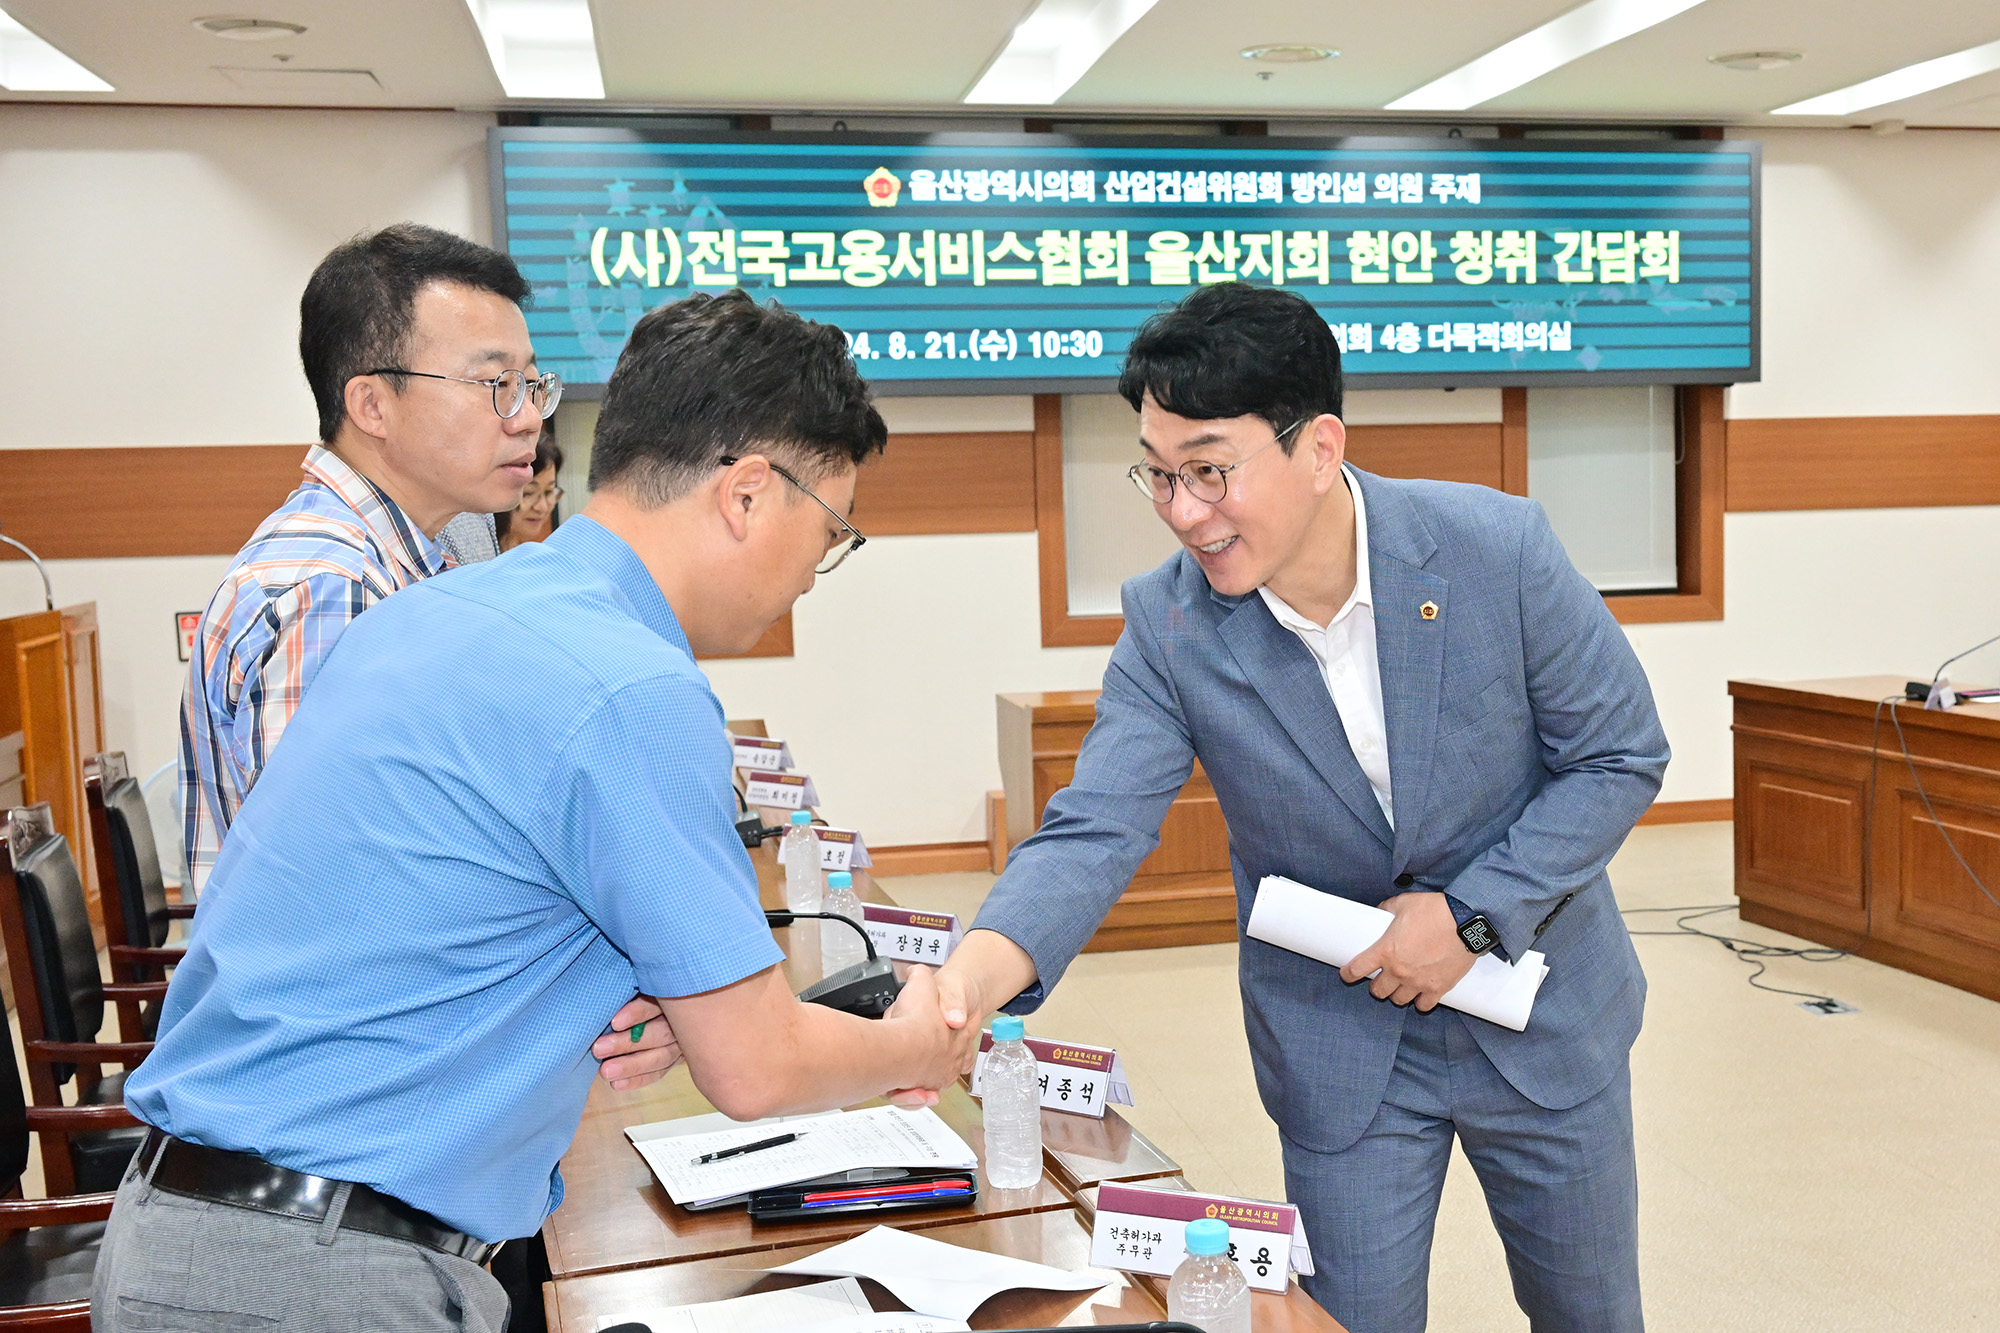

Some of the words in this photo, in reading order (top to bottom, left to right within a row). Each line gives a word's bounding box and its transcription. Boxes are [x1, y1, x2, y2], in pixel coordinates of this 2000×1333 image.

[908, 169, 1096, 203] 울산광역시의회
[1103, 170, 1283, 204] 산업건설위원회
[1291, 171, 1366, 204] 방인섭
[1373, 172, 1423, 204] 의원
[1429, 173, 1481, 204] 주재
[590, 227, 1130, 287] (사)전국고용서비스협회
[1145, 230, 1329, 286] 울산지회
[1346, 230, 1437, 284] 현안
[1449, 230, 1537, 285] 청취
[1553, 230, 1680, 284] 간담회
[888, 331, 916, 360] 8.
[924, 328, 1018, 361] 21.(수)
[1028, 330, 1103, 358] 10:30
[1380, 322, 1422, 354] 4층
[1427, 321, 1572, 353] 다목적회의실
[896, 934, 940, 956] 장경욱
[1220, 1205, 1279, 1221] 울산광역시의회
[1109, 1227, 1163, 1245] 건축허가과
[1116, 1243, 1153, 1260] 주무관
